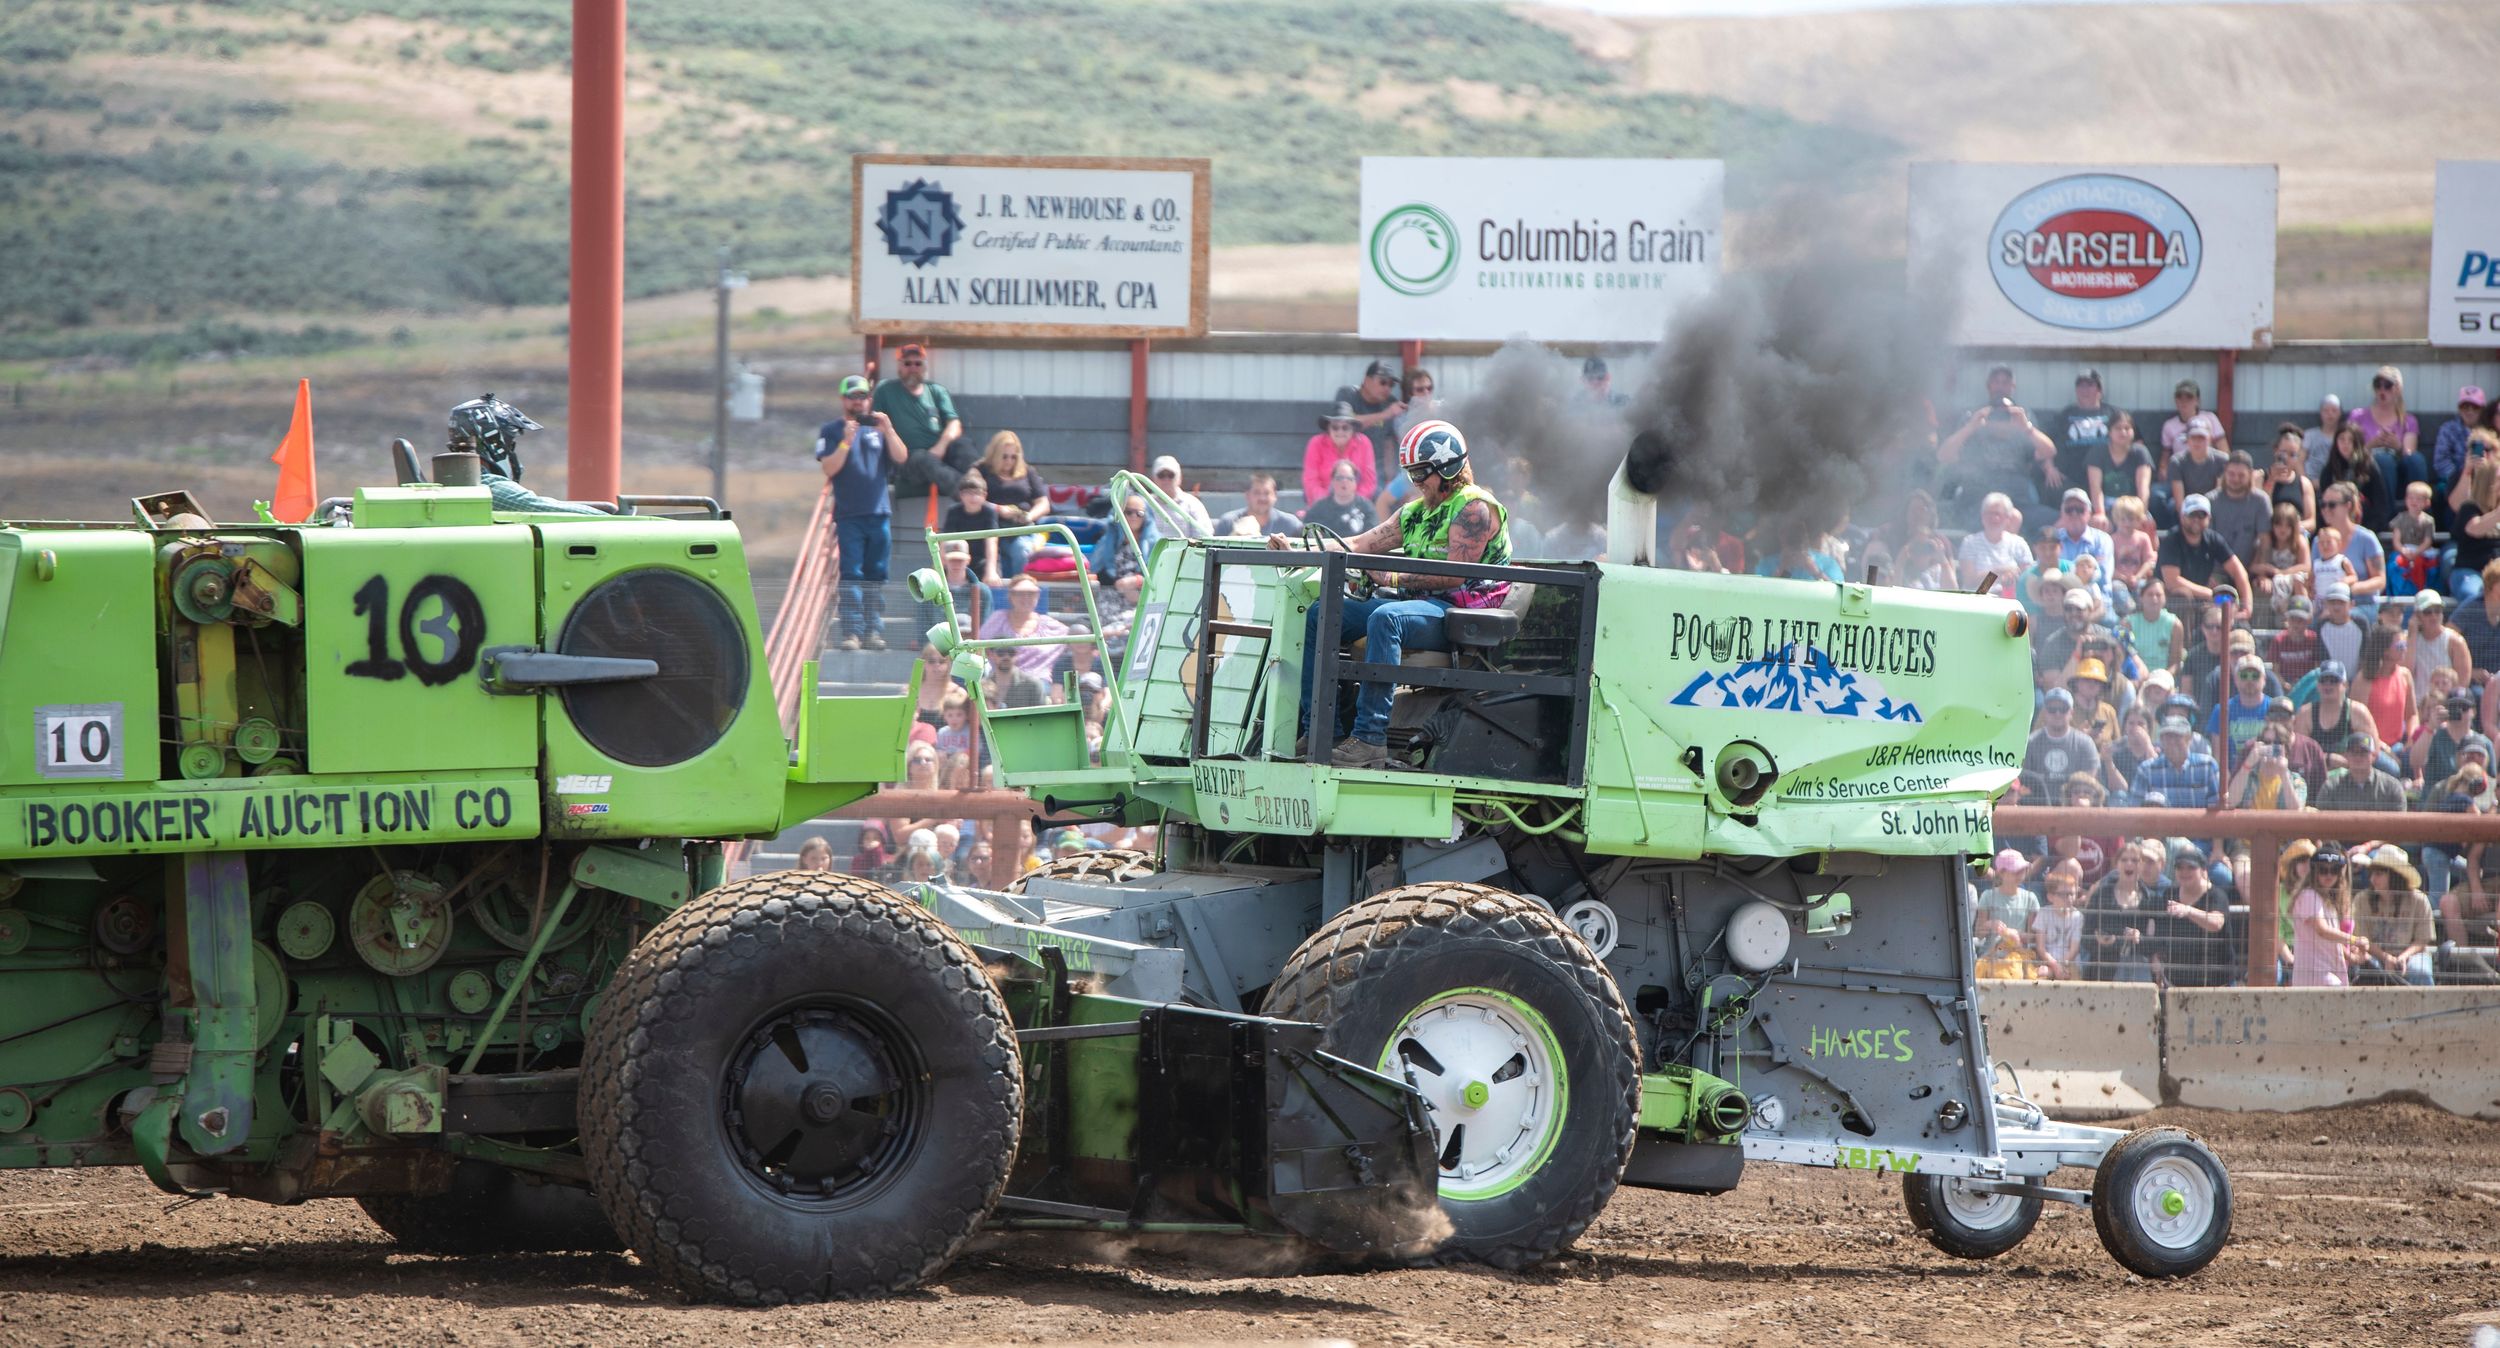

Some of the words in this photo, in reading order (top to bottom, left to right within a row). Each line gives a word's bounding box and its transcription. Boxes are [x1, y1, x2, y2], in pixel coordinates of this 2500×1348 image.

[976, 194, 991, 217] J.
[1001, 194, 1017, 218] R.
[1024, 195, 1127, 221] NEWHOUSE
[1134, 204, 1144, 221] &
[1152, 198, 1180, 222] CO.
[2023, 184, 2167, 223] CONTRACTORS
[972, 230, 1040, 252] Certified
[1044, 232, 1091, 251] Public
[1095, 234, 1184, 254] Accountants
[1479, 218, 1617, 262] Columbia
[1629, 219, 1705, 263] Grain
[2002, 230, 2188, 268] SCARSELLA
[903, 276, 960, 304] ALAN
[969, 277, 1107, 310] SCHLIMMER,
[1116, 281, 1158, 309] CPA
[1478, 271, 1585, 289] CULTIVATING
[1594, 272, 1664, 290] GROWTH
[2051, 270, 2113, 289] BROTHERS
[1135, 617, 1157, 663] 2
[1761, 618, 1820, 668] LIFE
[1827, 622, 1938, 677] CHOICES
[50, 720, 111, 763] 10
[1866, 746, 1901, 767] J&R
[1903, 745, 1984, 767] Hennings
[1989, 745, 2020, 769] Inc.
[1194, 764, 1246, 799] BRYDEN
[1786, 775, 1824, 798] Jim's
[1829, 777, 1890, 798] Service
[1893, 775, 1950, 793] Center
[29, 798, 212, 847] BOOKER
[240, 787, 431, 839] AUCTION
[455, 786, 512, 830] CO
[1255, 795, 1312, 829] TREVOR
[1882, 810, 1908, 835] St.
[1913, 809, 1959, 835] John
[1810, 1024, 1914, 1062] HAASE'S
